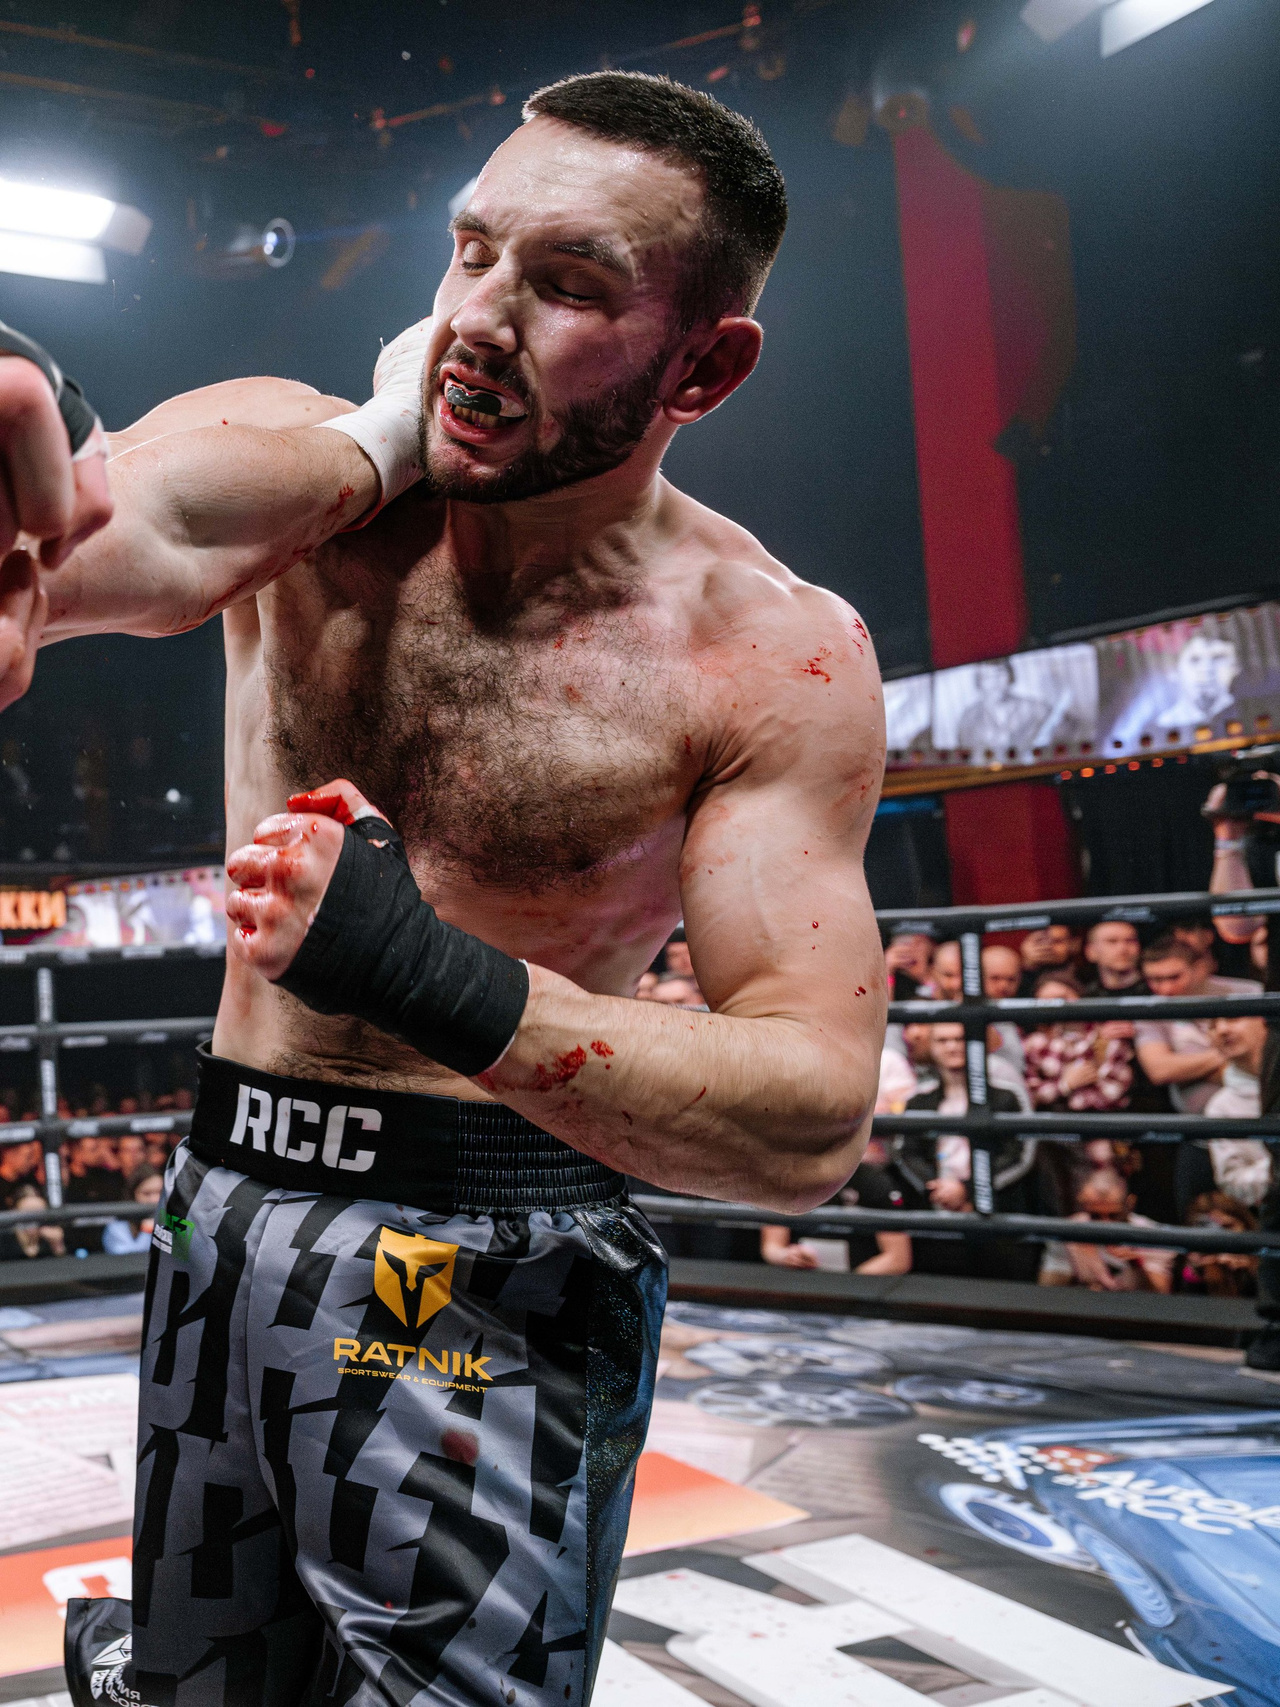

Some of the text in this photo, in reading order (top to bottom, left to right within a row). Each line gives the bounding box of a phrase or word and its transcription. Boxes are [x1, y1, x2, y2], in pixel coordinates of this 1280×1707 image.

[229, 1083, 382, 1172] RCC
[333, 1337, 494, 1382] RATNIK
[337, 1367, 411, 1382] SPORTSWEAR
[421, 1378, 488, 1394] EQUIPMENT
